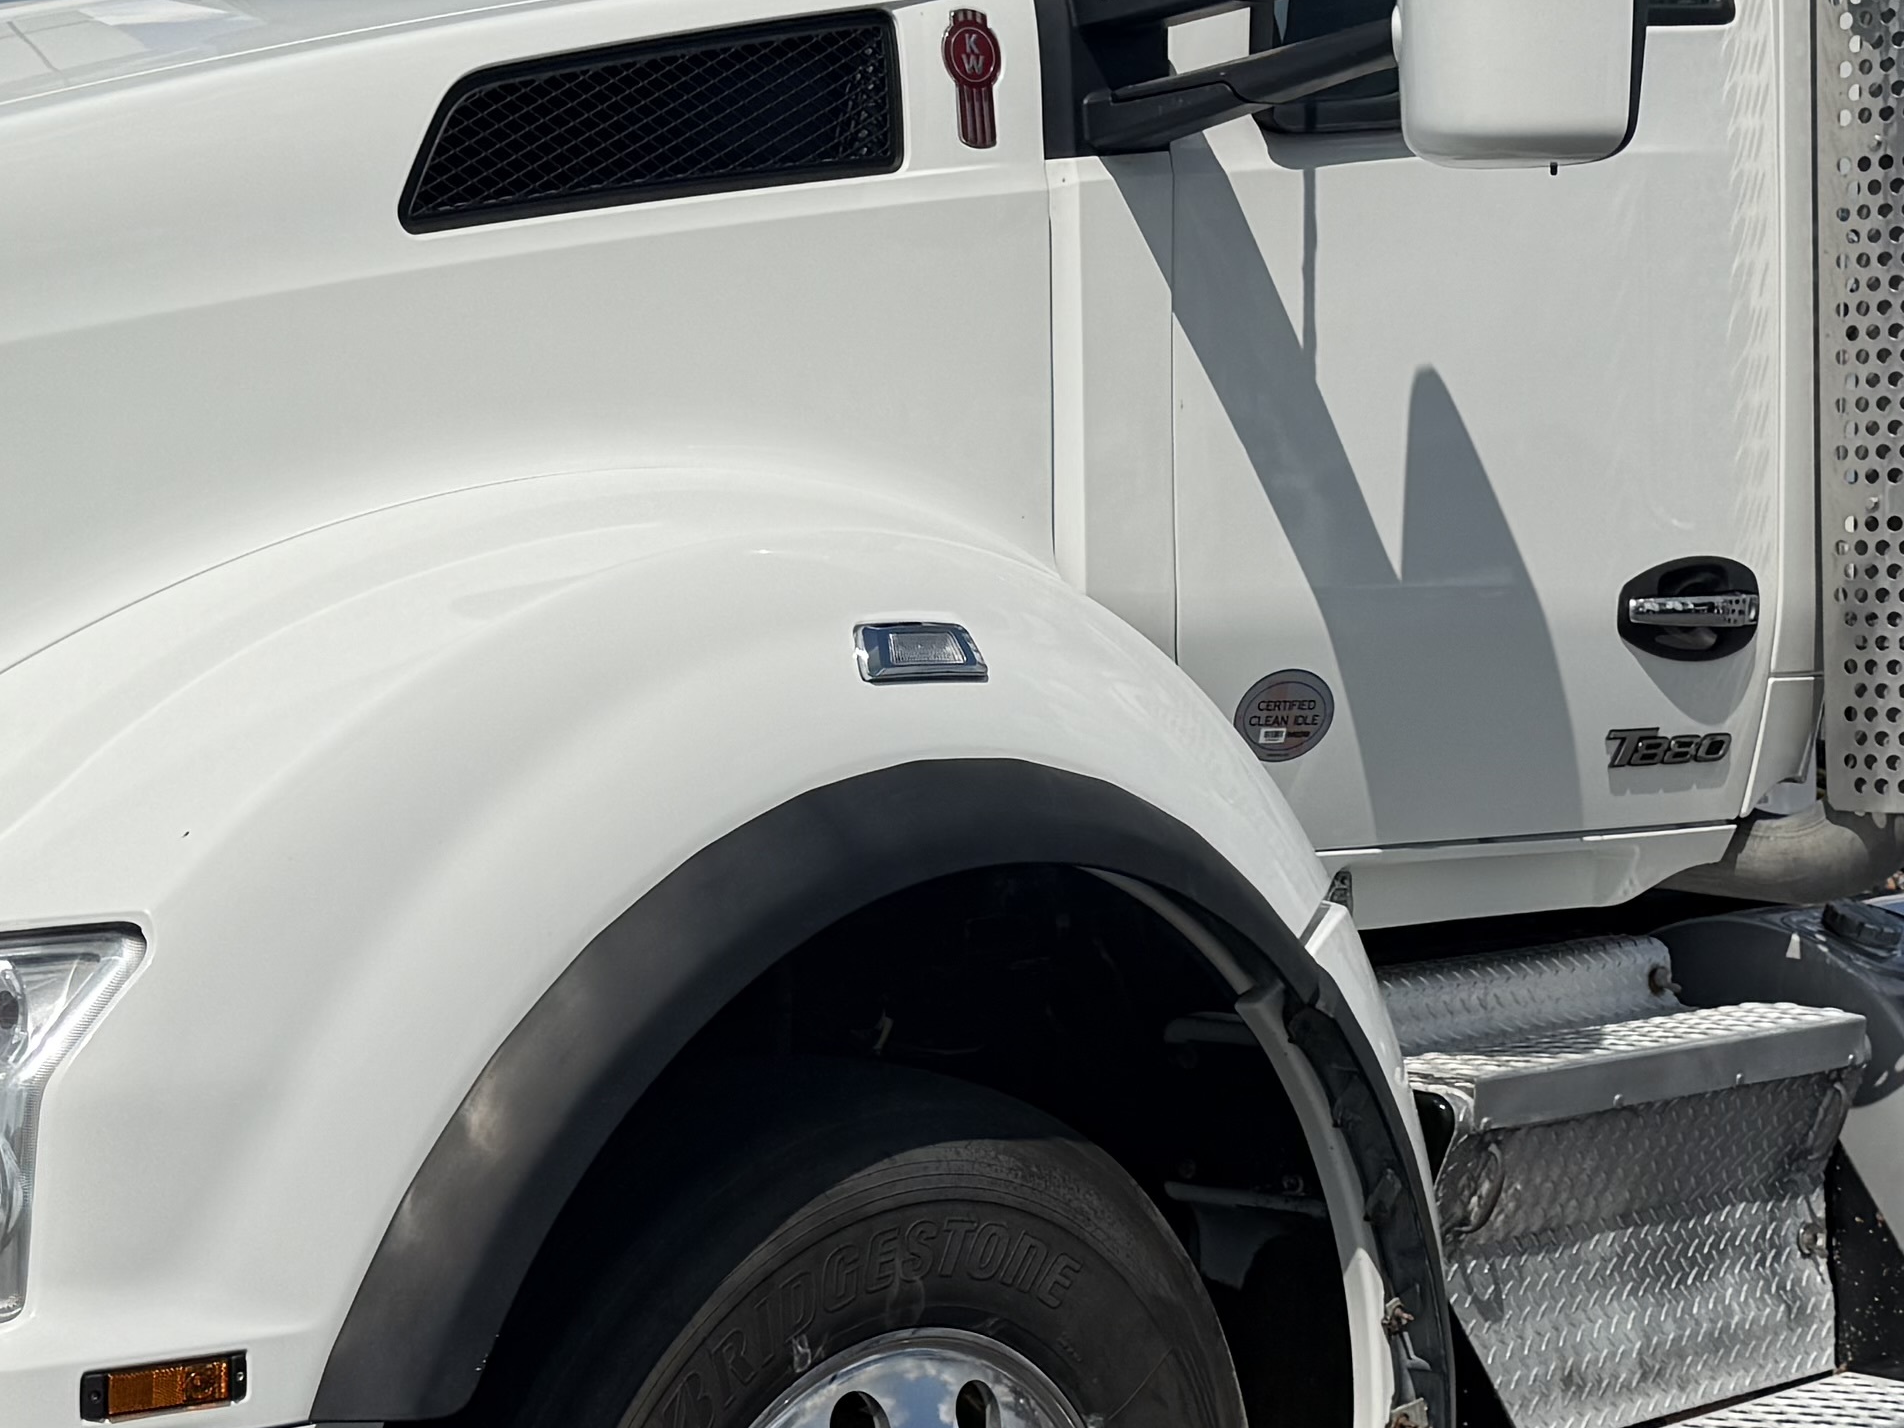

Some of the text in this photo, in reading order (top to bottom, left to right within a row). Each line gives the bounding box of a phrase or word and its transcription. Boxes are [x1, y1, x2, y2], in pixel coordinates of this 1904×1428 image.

[1257, 699, 1317, 712] CERTIFIED
[1248, 714, 1321, 727] CLEAN IDLE
[1605, 726, 1733, 768] T880
